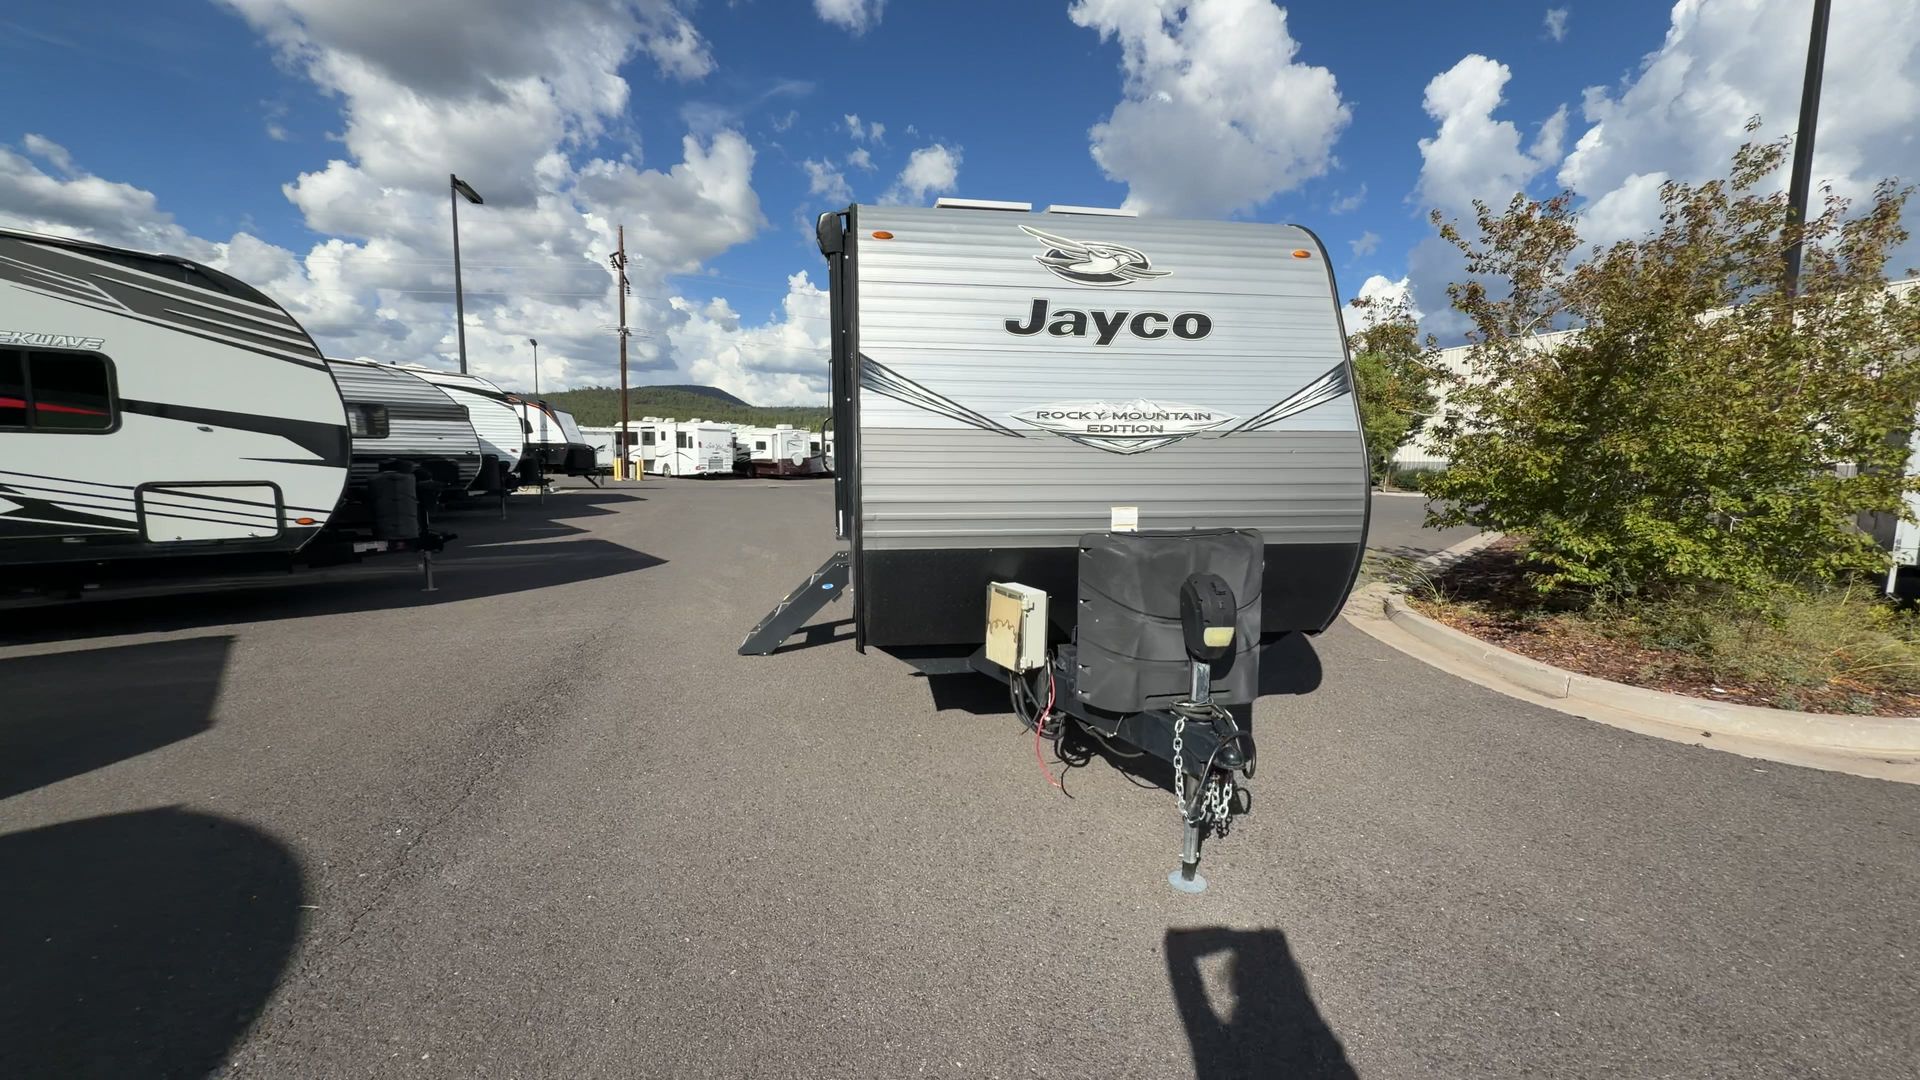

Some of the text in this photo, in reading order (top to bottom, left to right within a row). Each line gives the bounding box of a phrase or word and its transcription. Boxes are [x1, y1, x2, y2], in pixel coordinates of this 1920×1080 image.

[1004, 297, 1213, 347] Jayco
[1036, 411, 1212, 421] ROCKY MOUNTAIN
[1086, 424, 1164, 433] EDITION
